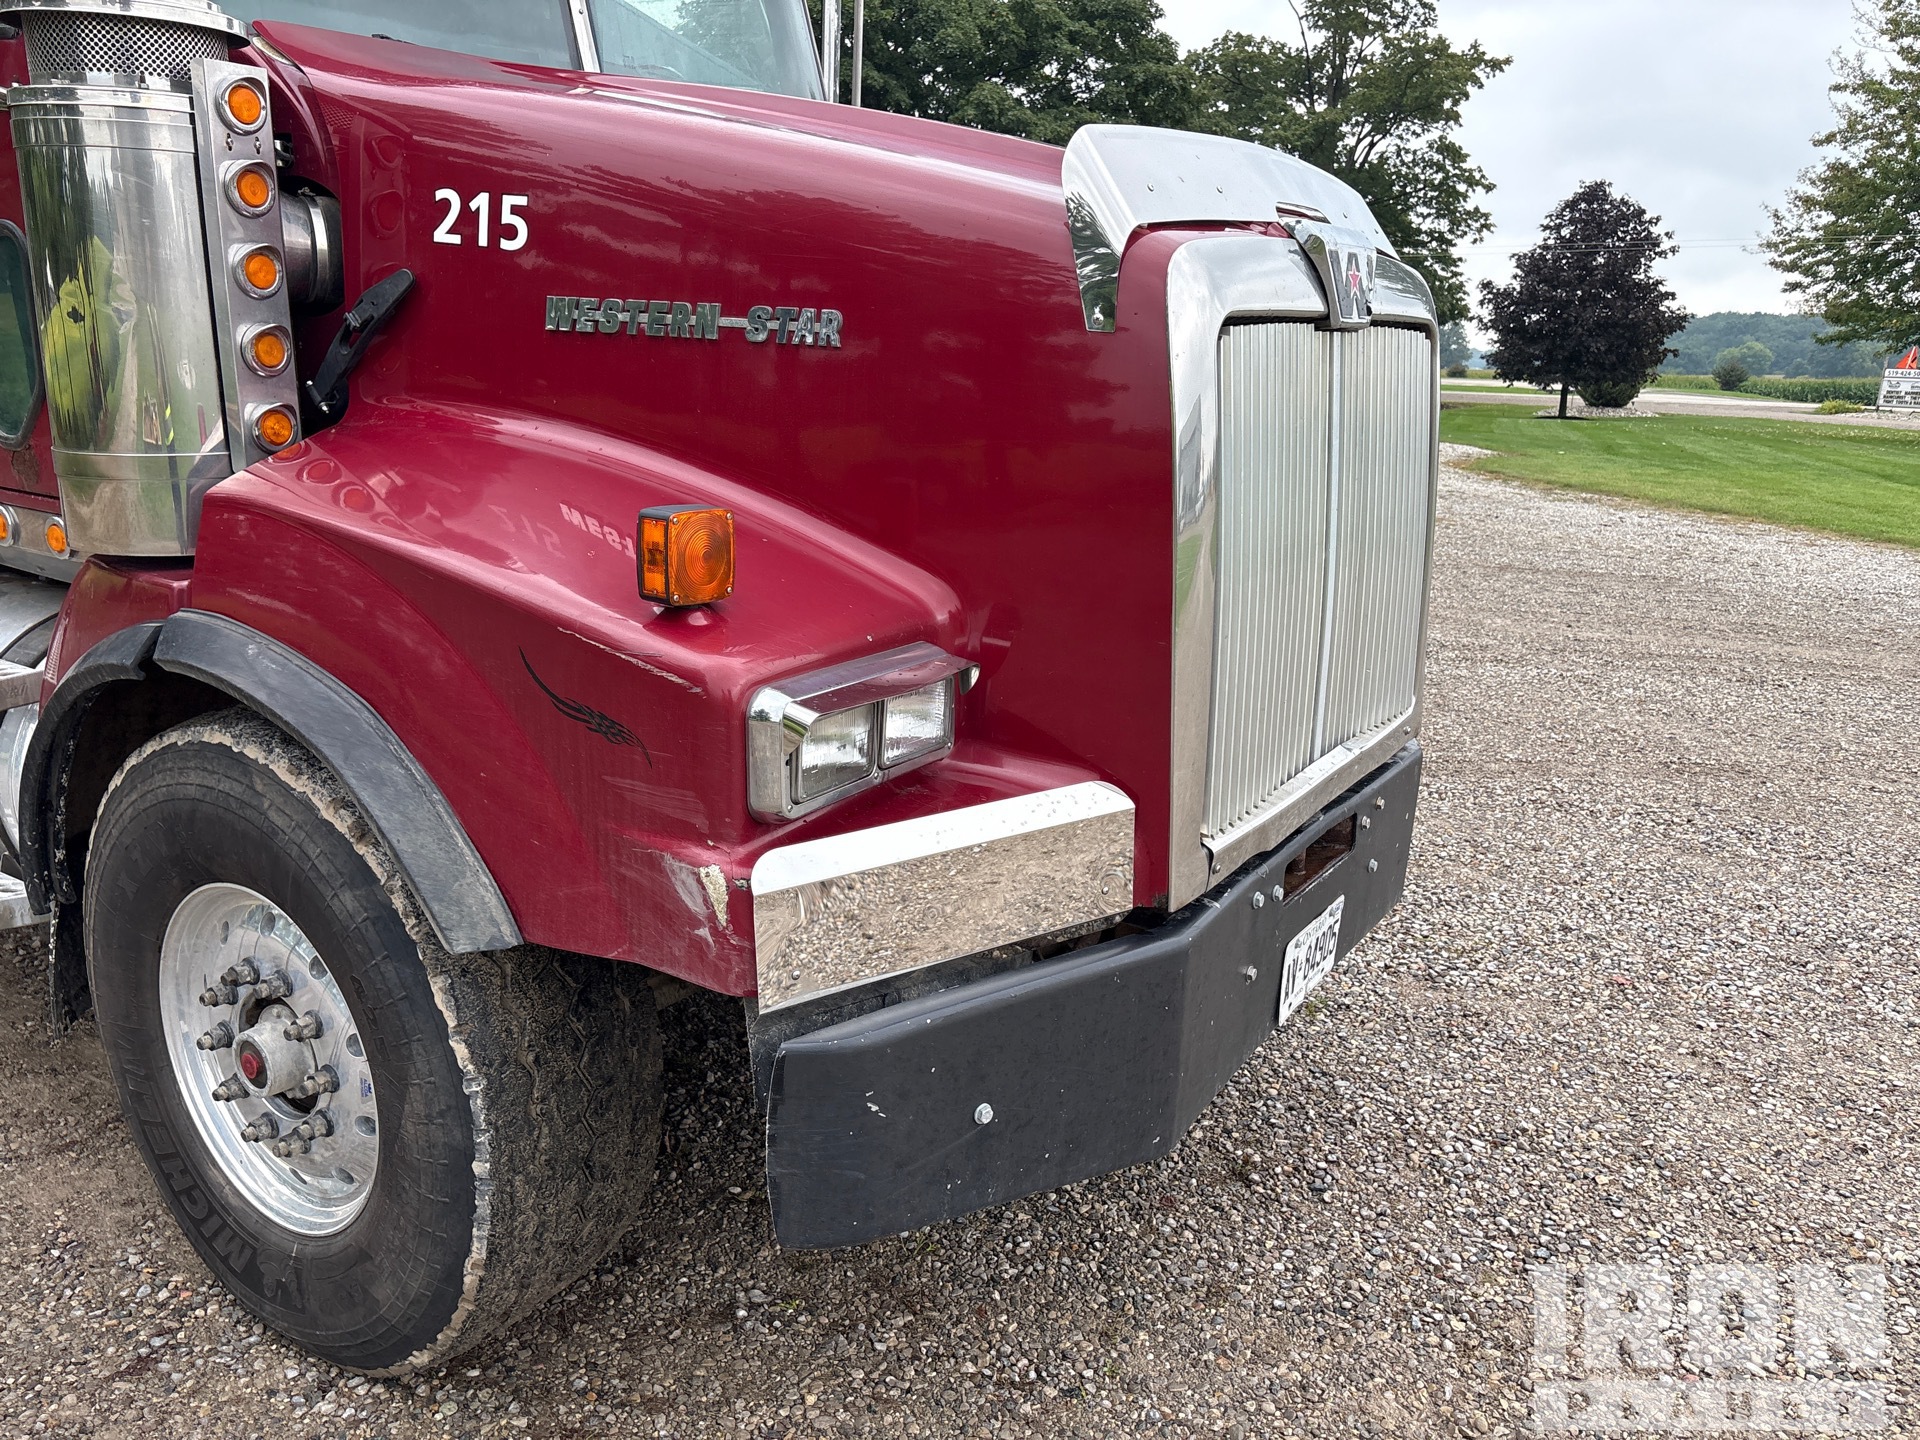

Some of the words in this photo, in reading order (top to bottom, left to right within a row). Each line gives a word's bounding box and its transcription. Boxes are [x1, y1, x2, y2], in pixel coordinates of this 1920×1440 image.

[432, 188, 529, 251] 215
[545, 295, 721, 340] WESTERN
[745, 305, 843, 348] STAR
